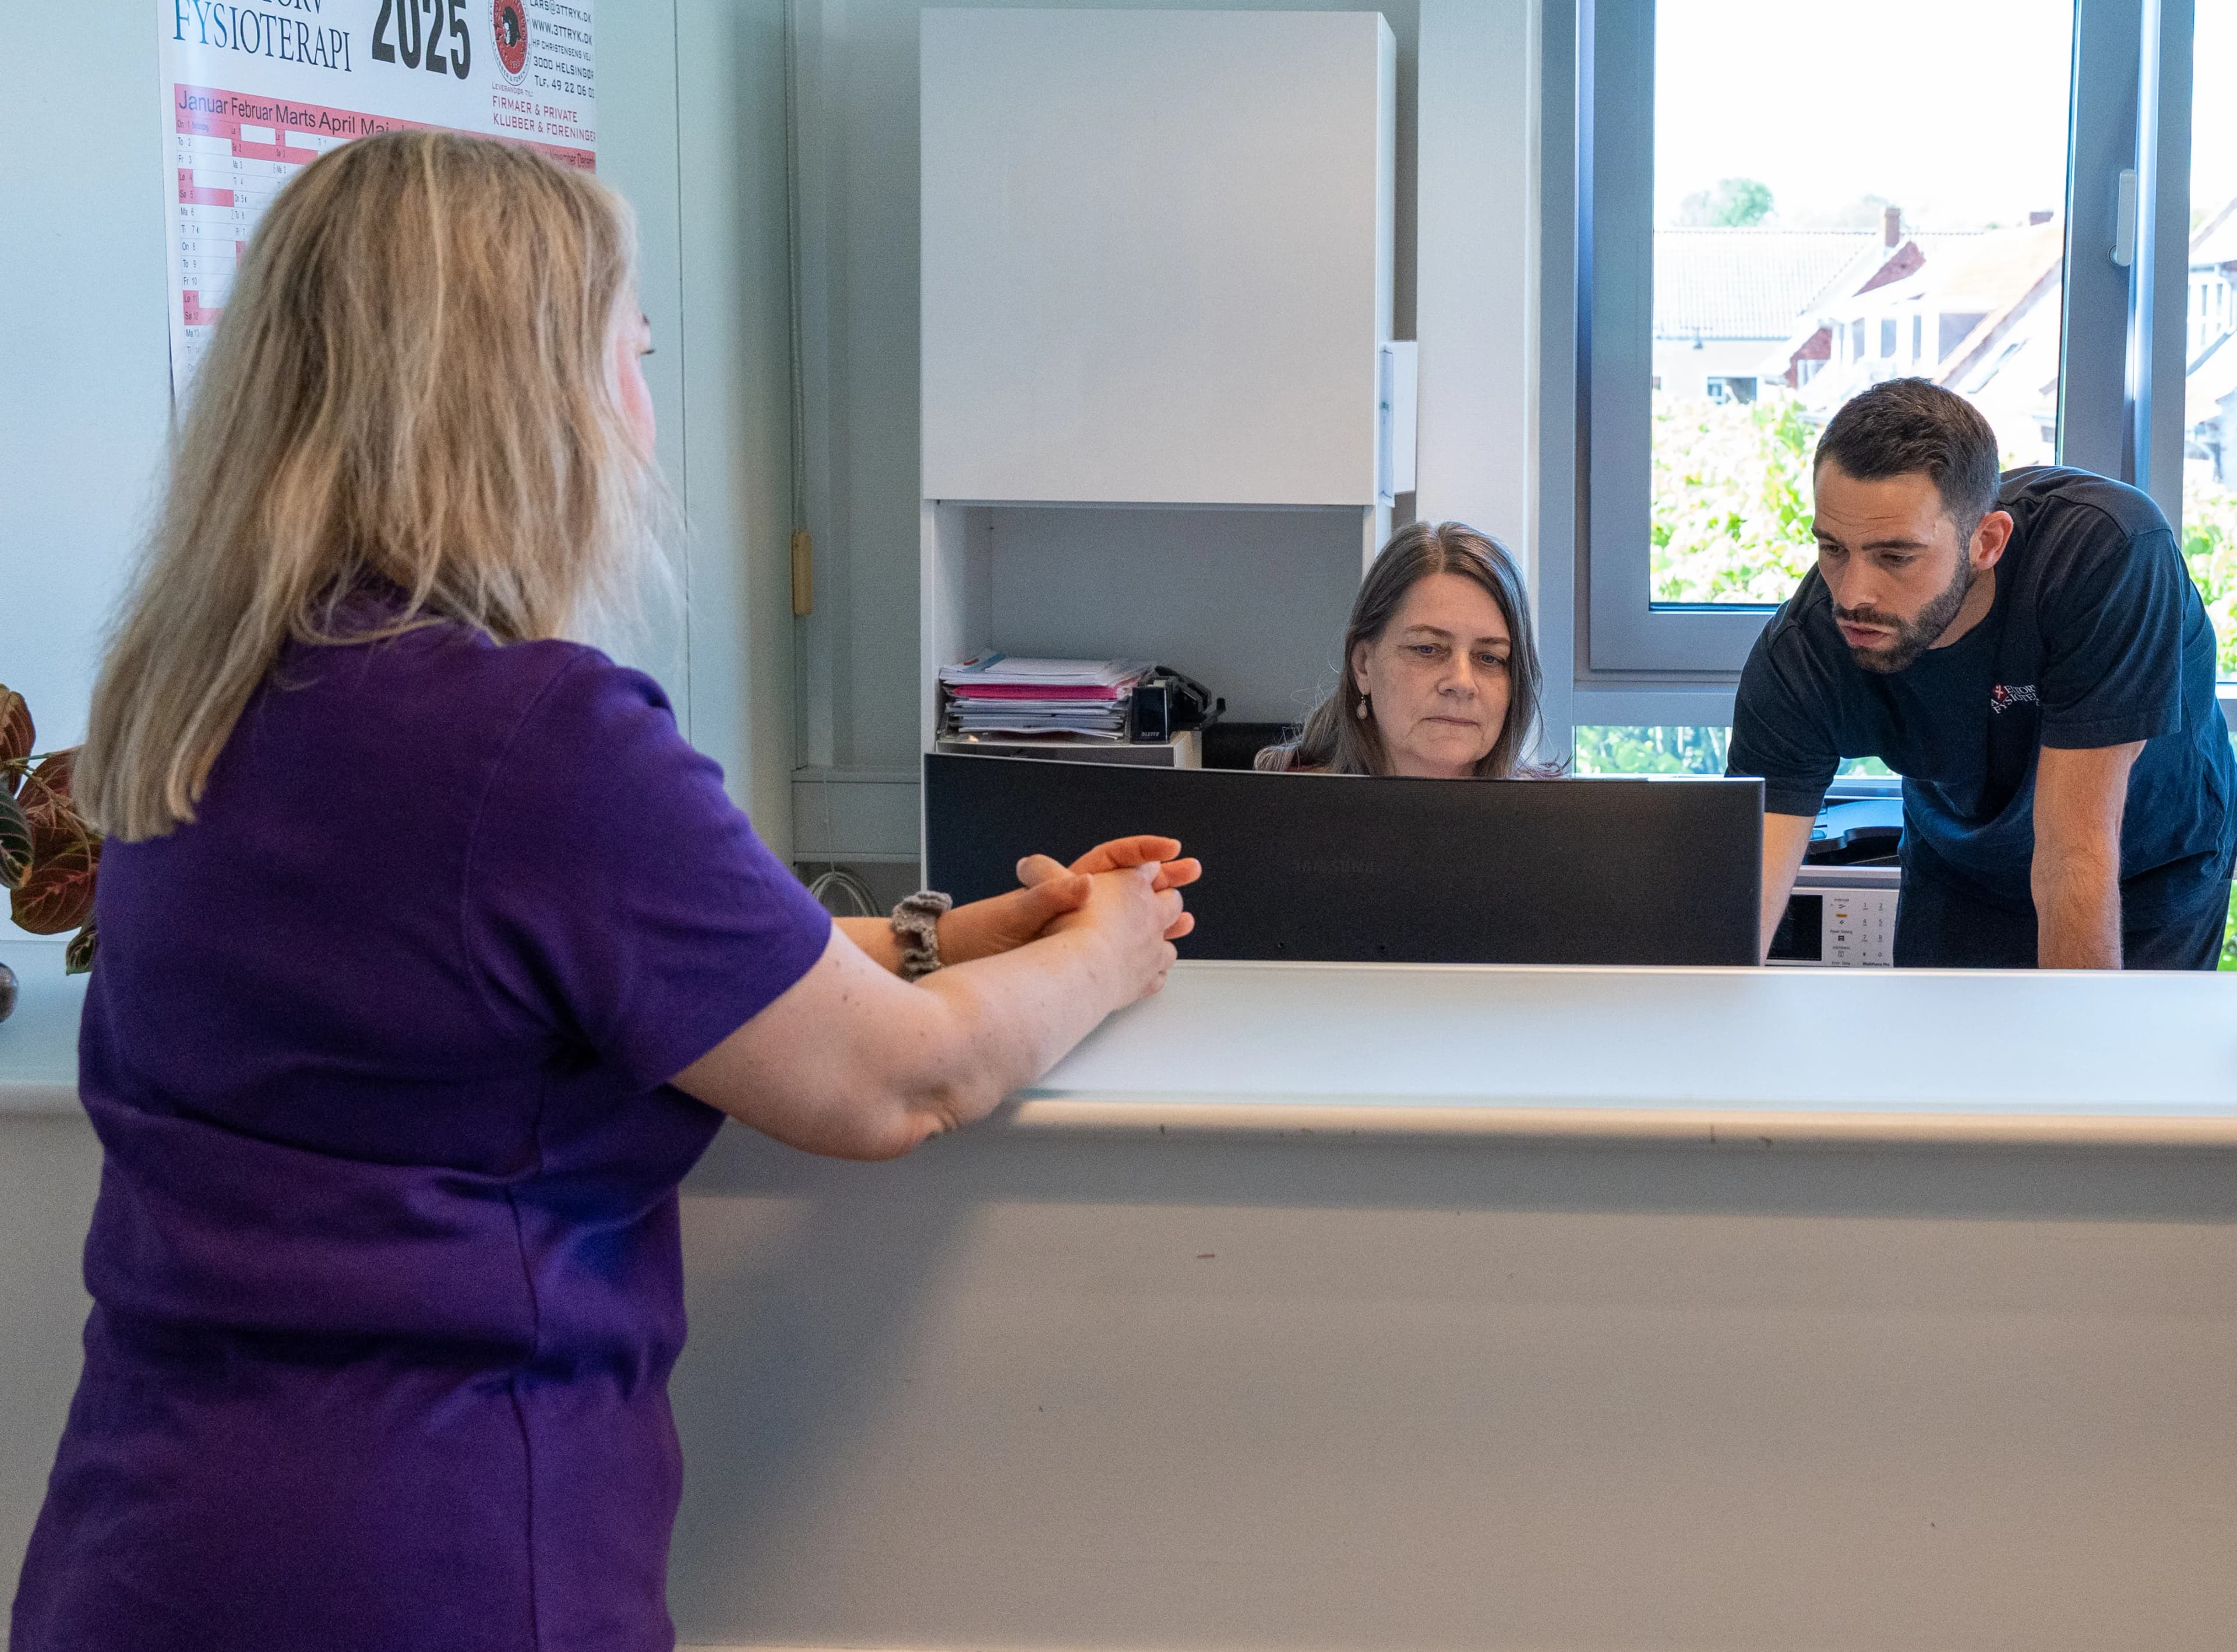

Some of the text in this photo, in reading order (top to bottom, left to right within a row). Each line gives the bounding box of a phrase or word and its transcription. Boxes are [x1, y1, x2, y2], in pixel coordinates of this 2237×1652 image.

[173, 0, 351, 72] FYSIOTERAPI
[372, 0, 471, 80] 2025
[532, 19, 592, 45] WWW.3TTRYK.DK
[542, 41, 581, 59] CHRISTENSENS
[534, 57, 553, 69] 3000
[556, 62, 594, 81] HELSINGØR
[552, 79, 561, 90] 49
[564, 82, 574, 93] 22
[577, 84, 586, 97] 06
[179, 90, 228, 114] Januar
[231, 97, 273, 121] Februar
[276, 104, 316, 128] Marts
[319, 111, 355, 135] April
[493, 96, 578, 123] FIRMAER & PRIVATE
[493, 112, 595, 142] KLUBBER & FORENINGER
[178, 137, 191, 146] To 2
[178, 155, 192, 164] Fr 3
[181, 207, 188, 216] Ma
[191, 208, 194, 216] 6
[182, 242, 189, 250] On
[183, 259, 189, 268] To
[184, 277, 197, 285] Fr 10
